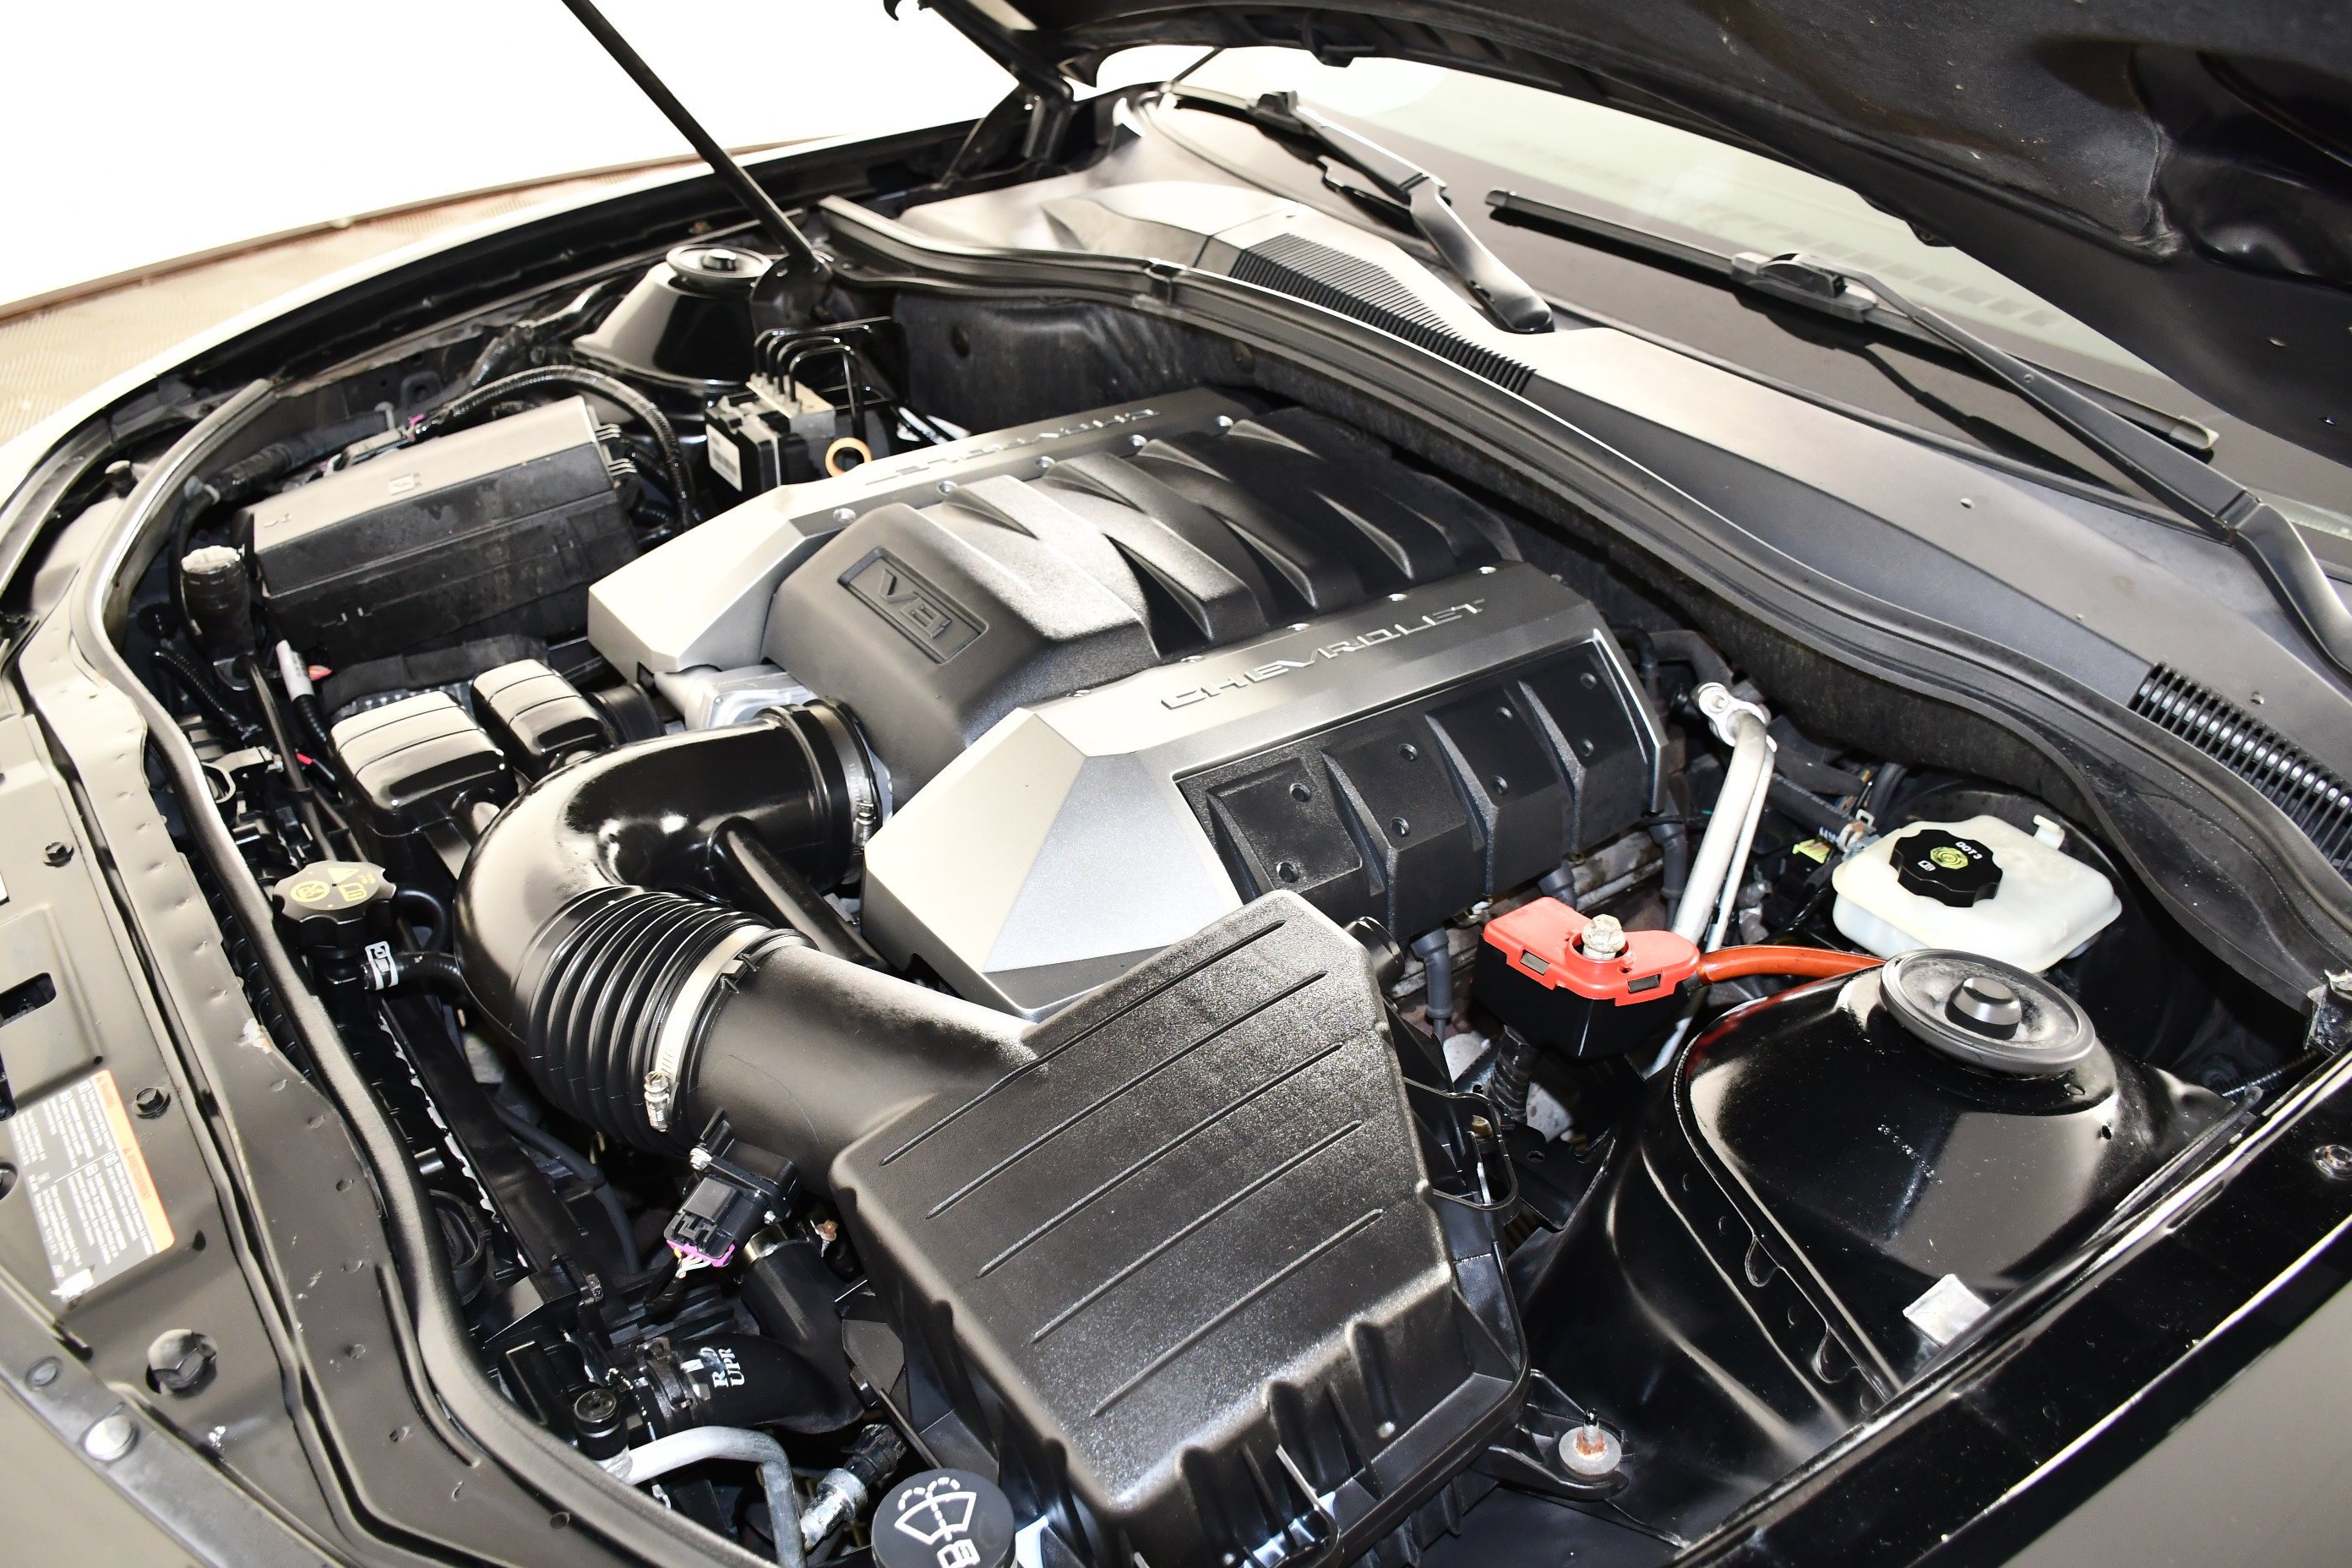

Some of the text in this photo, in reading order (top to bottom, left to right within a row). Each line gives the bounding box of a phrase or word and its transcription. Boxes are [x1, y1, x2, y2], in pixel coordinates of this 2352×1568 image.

[879, 569, 952, 639] V8
[1161, 599, 1485, 710] CHEVROLET
[718, 1348, 745, 1386] UPR
